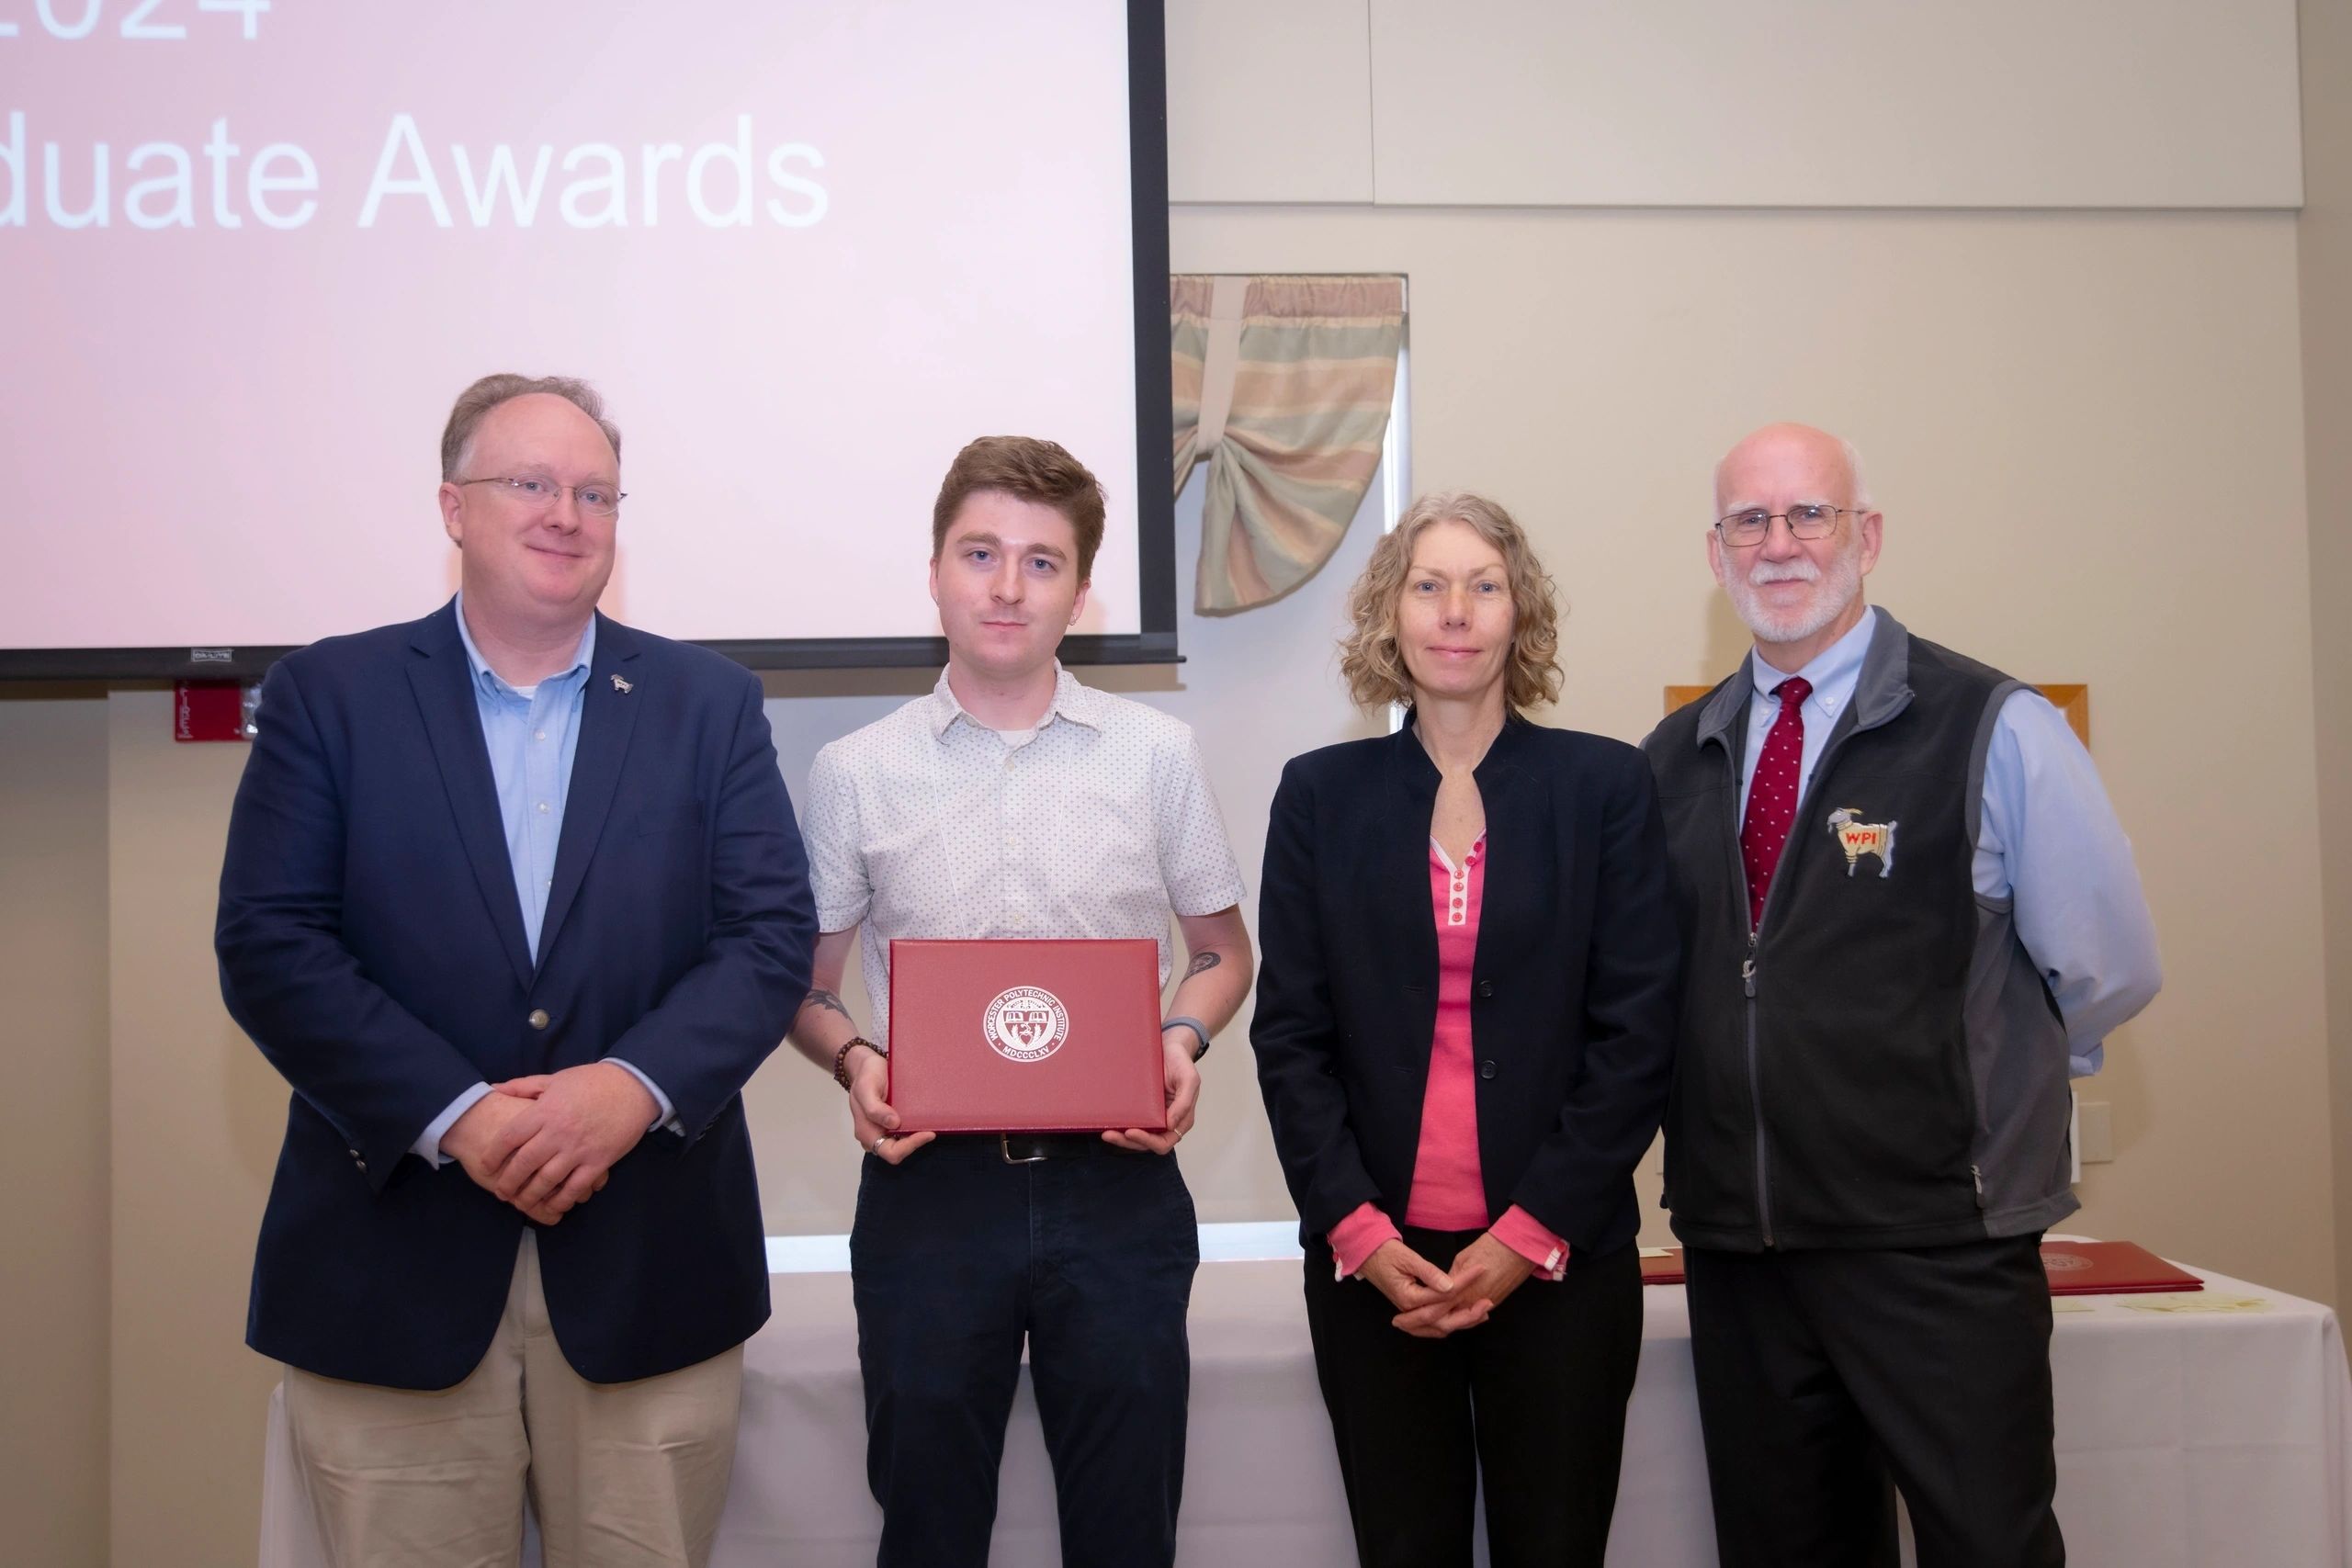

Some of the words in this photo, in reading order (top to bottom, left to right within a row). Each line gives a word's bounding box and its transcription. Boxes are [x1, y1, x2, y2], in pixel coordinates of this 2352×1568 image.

[357, 113, 829, 229] Awards
[1845, 832, 1877, 845] WPI
[987, 998, 1005, 1041] WORCESTER
[1003, 989, 1056, 1006] POLYTECHNIC
[1052, 1005, 1066, 1042] INSTITUTE
[1002, 1045, 1050, 1059] MDCCCLXV
